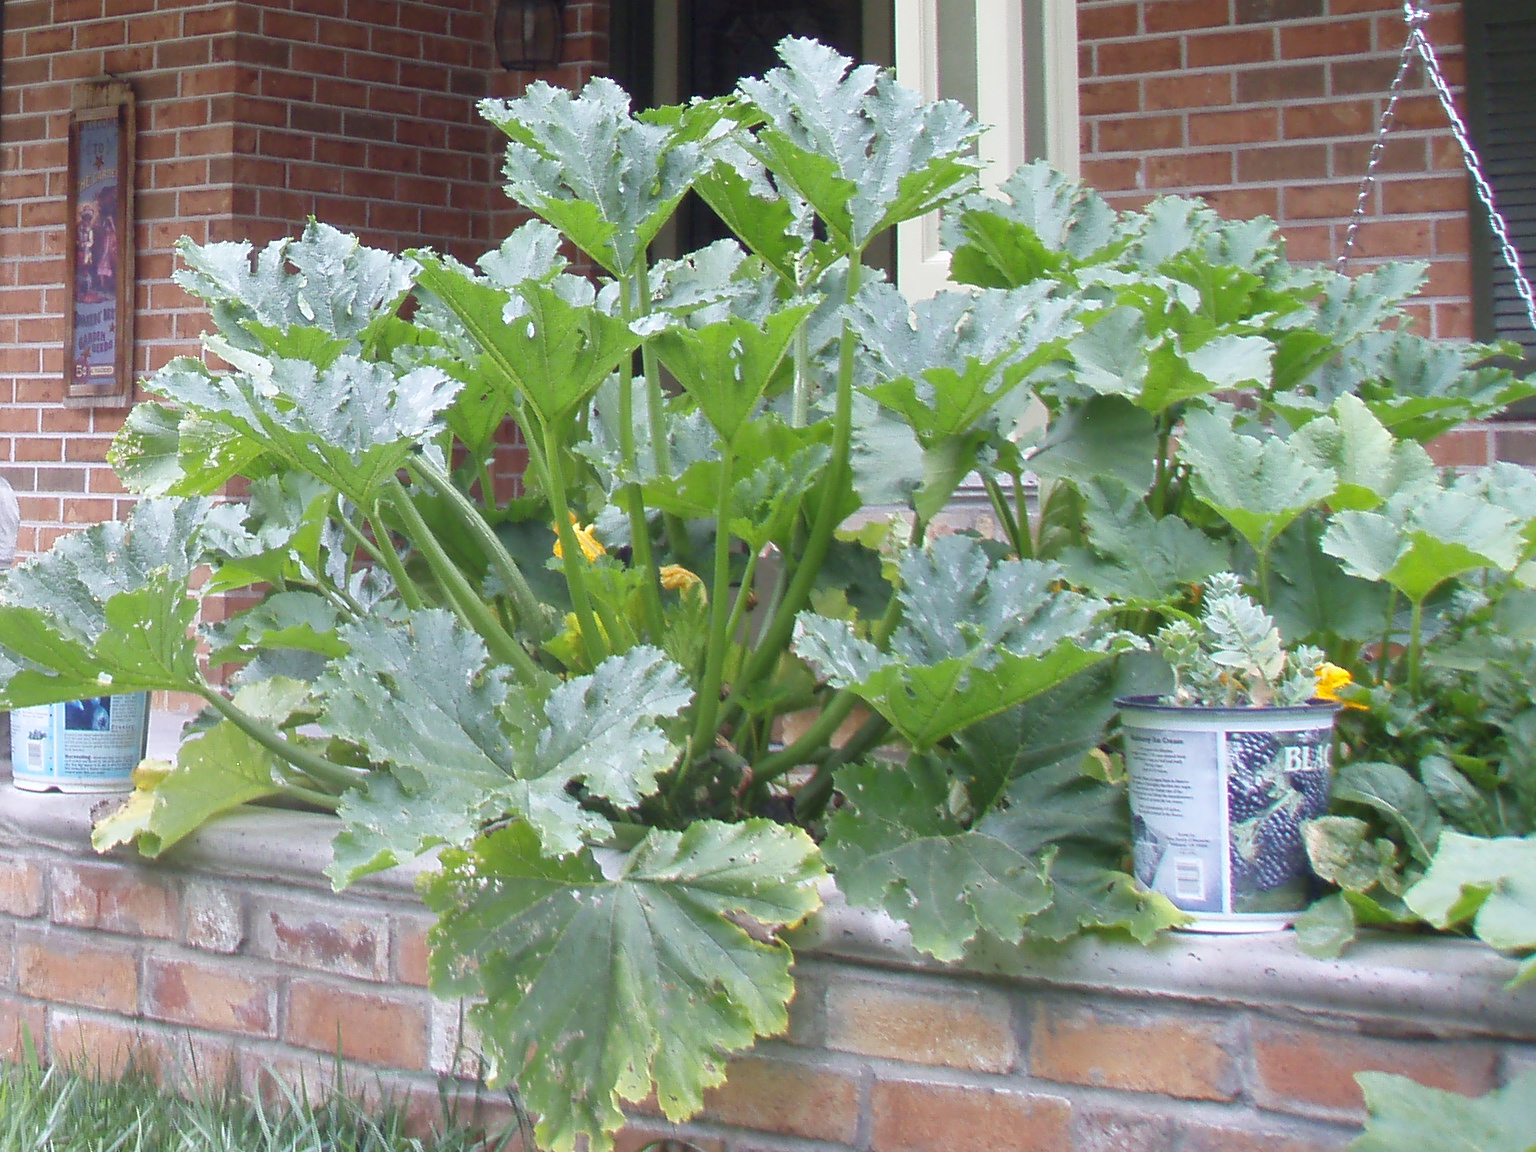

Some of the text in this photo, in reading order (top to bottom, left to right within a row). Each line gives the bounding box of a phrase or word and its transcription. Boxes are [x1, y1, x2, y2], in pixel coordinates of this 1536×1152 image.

[94, 142, 105, 154] TO
[93, 168, 119, 184] GARDE
[79, 331, 106, 350] GARDEN
[91, 340, 114, 354] SEEDS
